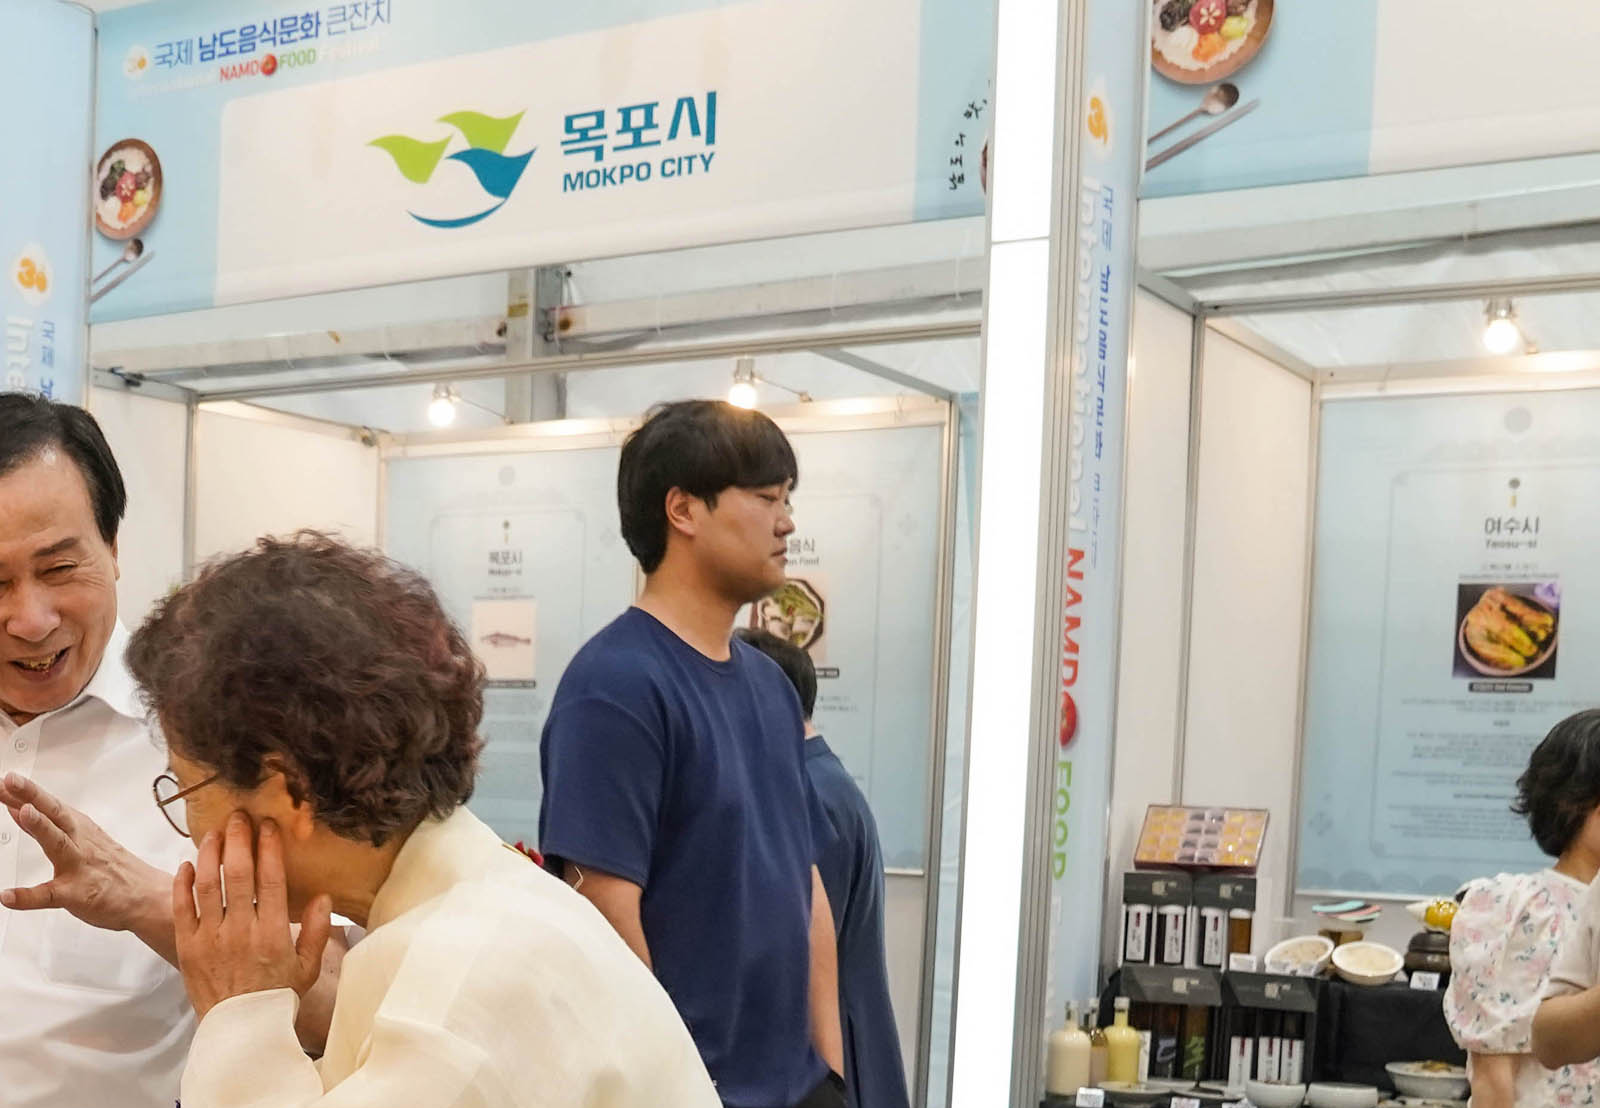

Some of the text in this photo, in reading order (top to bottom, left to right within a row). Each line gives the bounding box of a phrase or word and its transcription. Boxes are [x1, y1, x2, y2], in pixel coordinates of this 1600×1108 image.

[154, 39, 194, 69] 국제
[198, 11, 321, 63] 남도음식문화
[326, 0, 392, 35] 큰잔치
[279, 48, 317, 69] FOOD
[560, 90, 717, 162] 목포시
[563, 151, 716, 193] MOKPO CITY
[1484, 516, 1540, 535] 여수시
